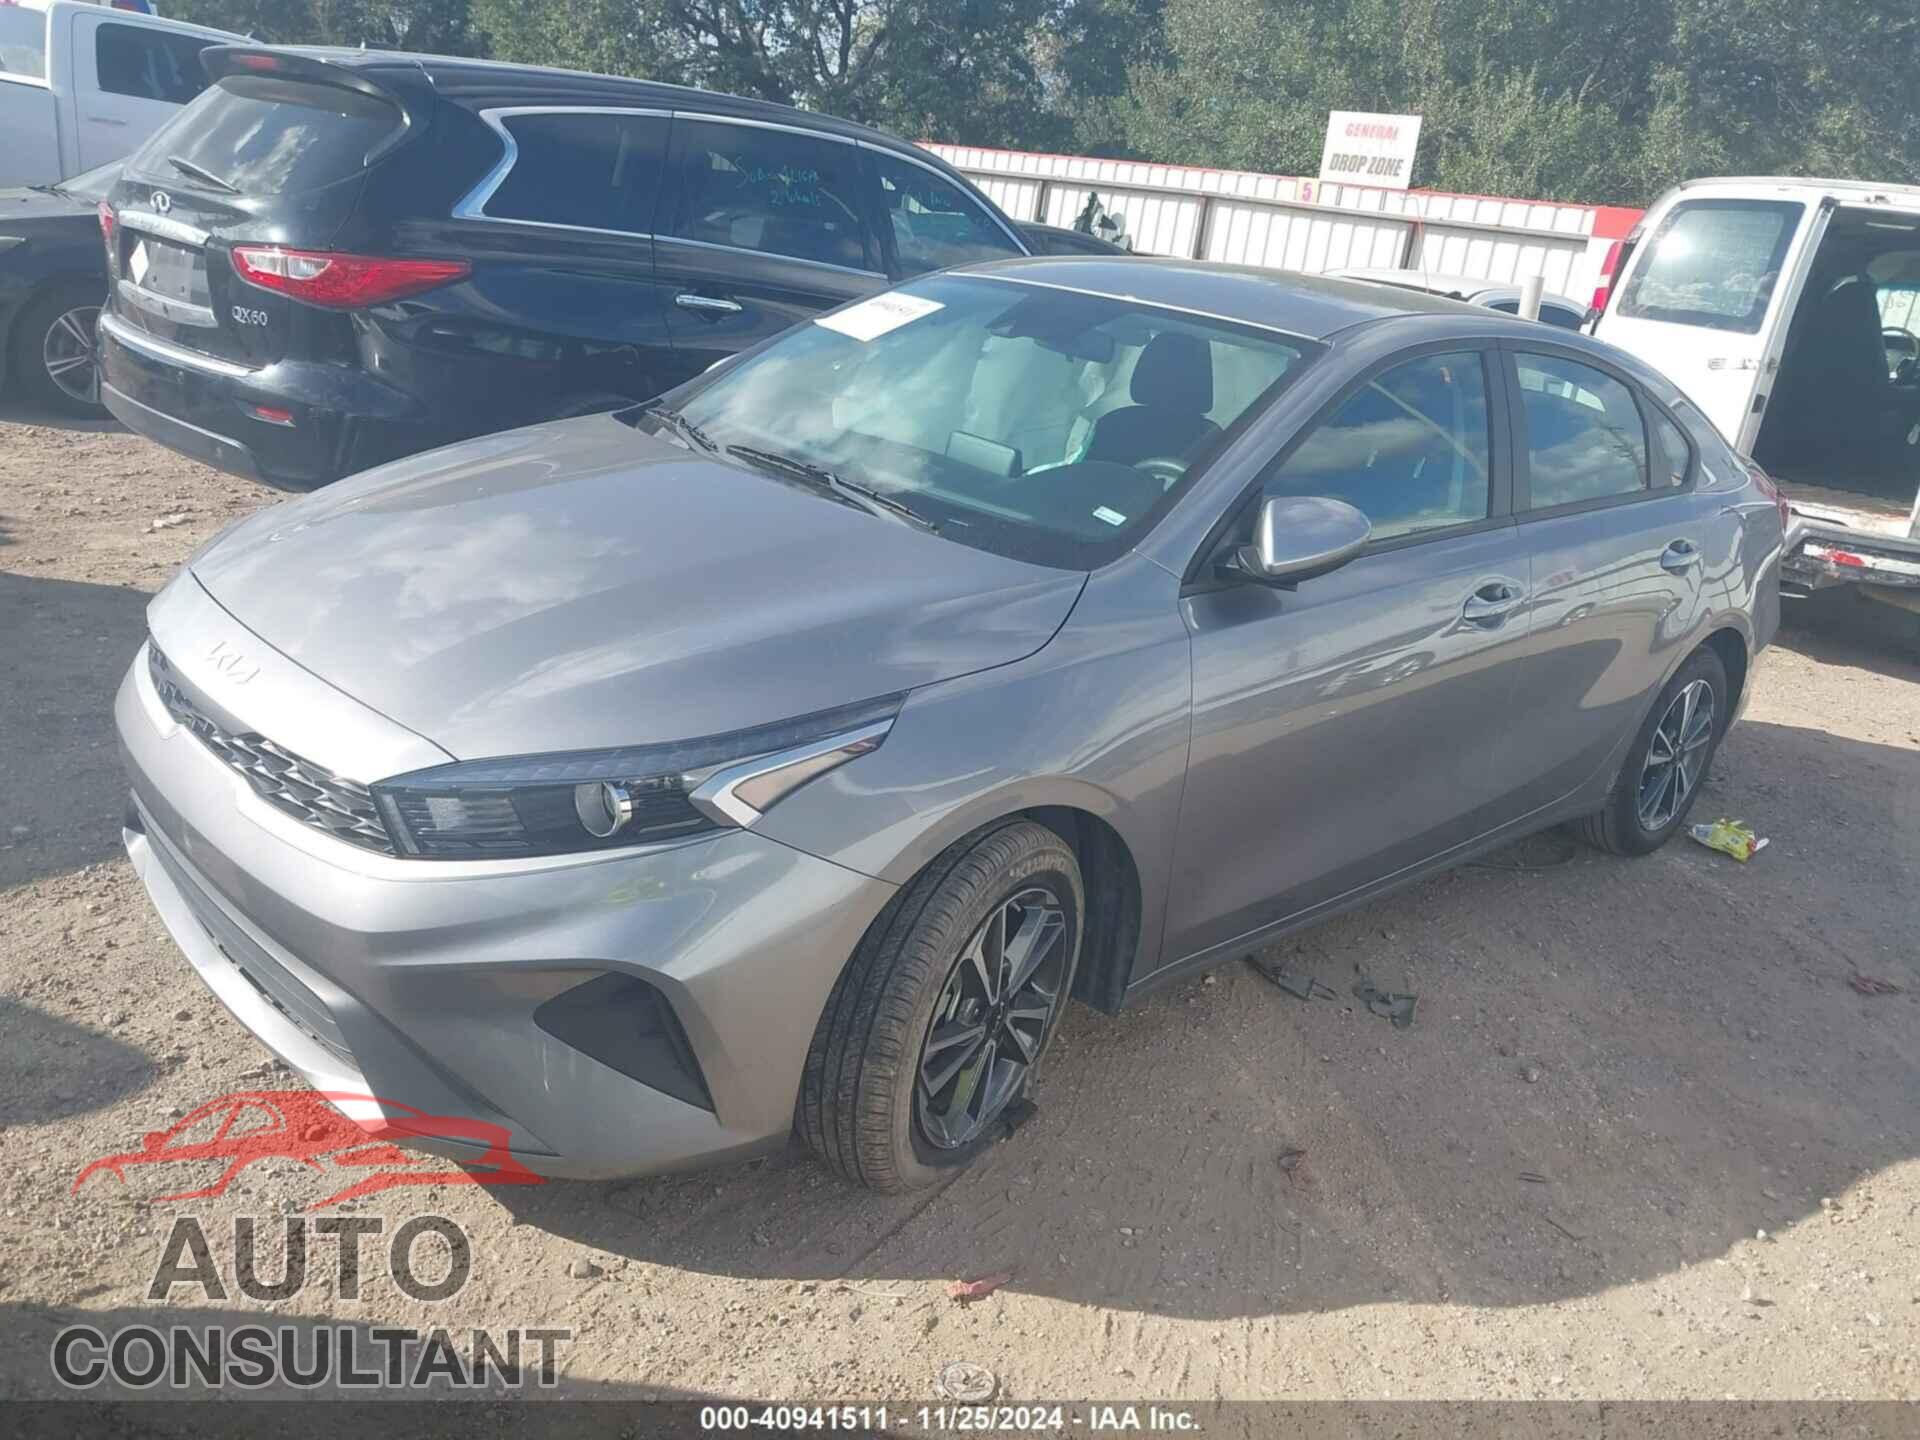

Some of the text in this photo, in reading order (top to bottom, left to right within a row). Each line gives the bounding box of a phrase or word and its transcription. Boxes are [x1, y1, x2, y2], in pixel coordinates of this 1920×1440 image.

[1345, 122, 1399, 141] GENERAL
[1329, 153, 1404, 177] DROP ZONE
[1301, 182, 1313, 201] 5
[231, 305, 269, 327] QX60
